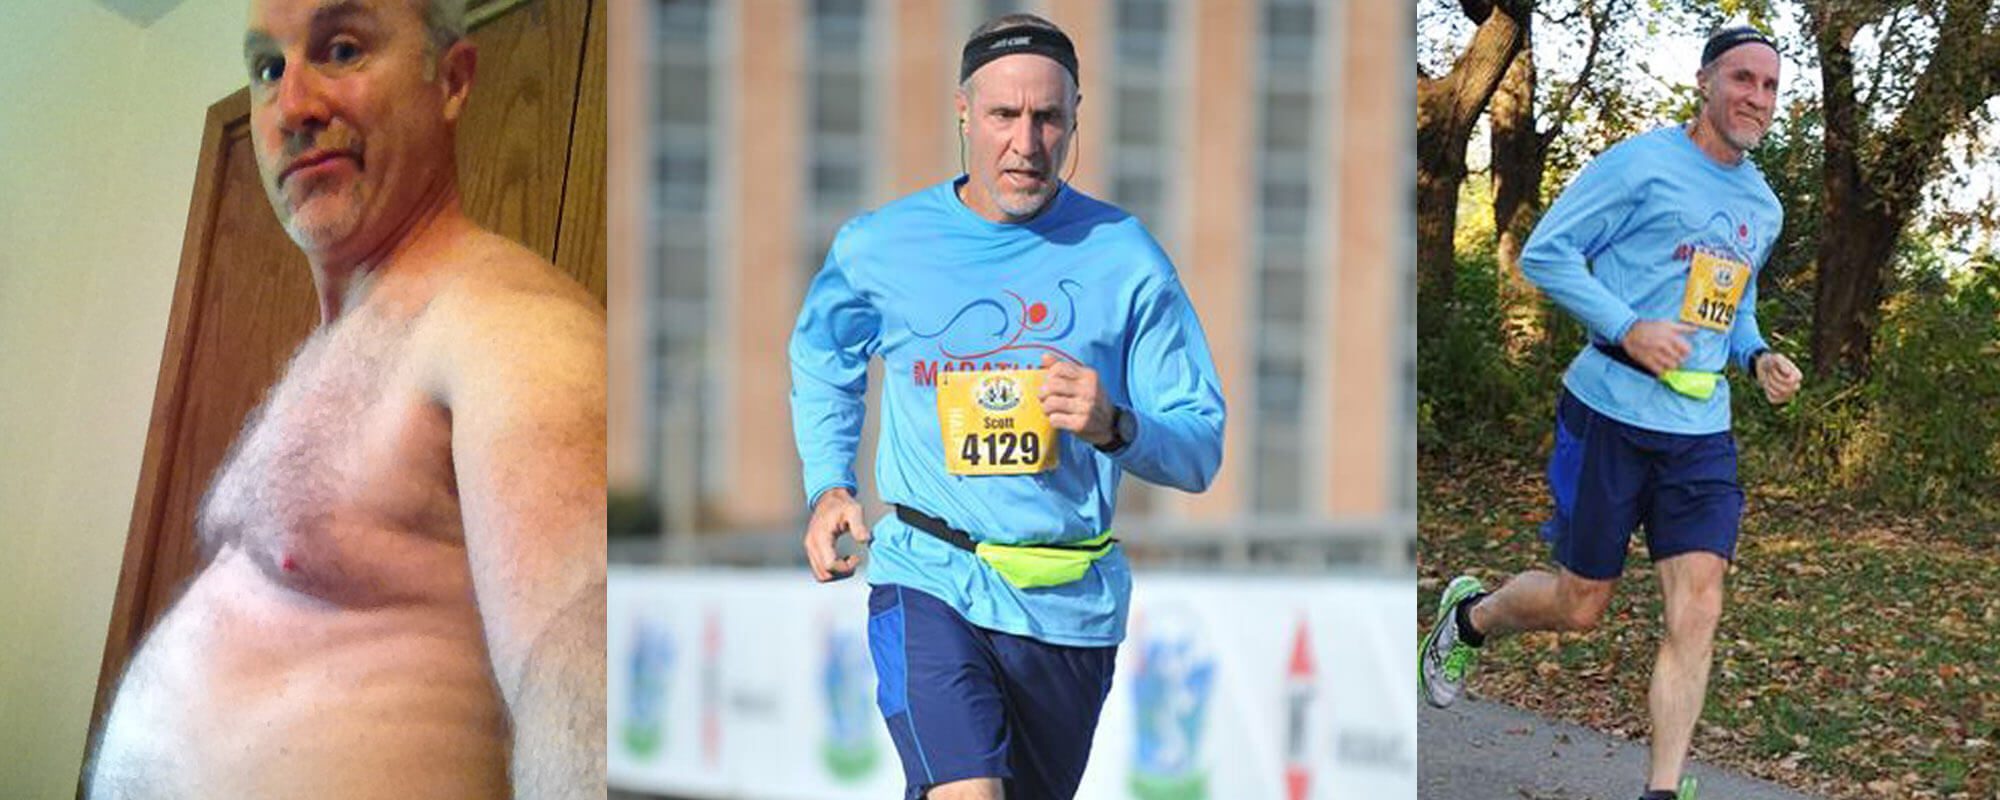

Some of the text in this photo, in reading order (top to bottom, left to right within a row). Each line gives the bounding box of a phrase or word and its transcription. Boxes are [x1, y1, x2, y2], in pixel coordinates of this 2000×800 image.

[1698, 298, 1735, 325] 4129
[984, 416, 1014, 429] Scott
[962, 431, 1039, 465] 4129
